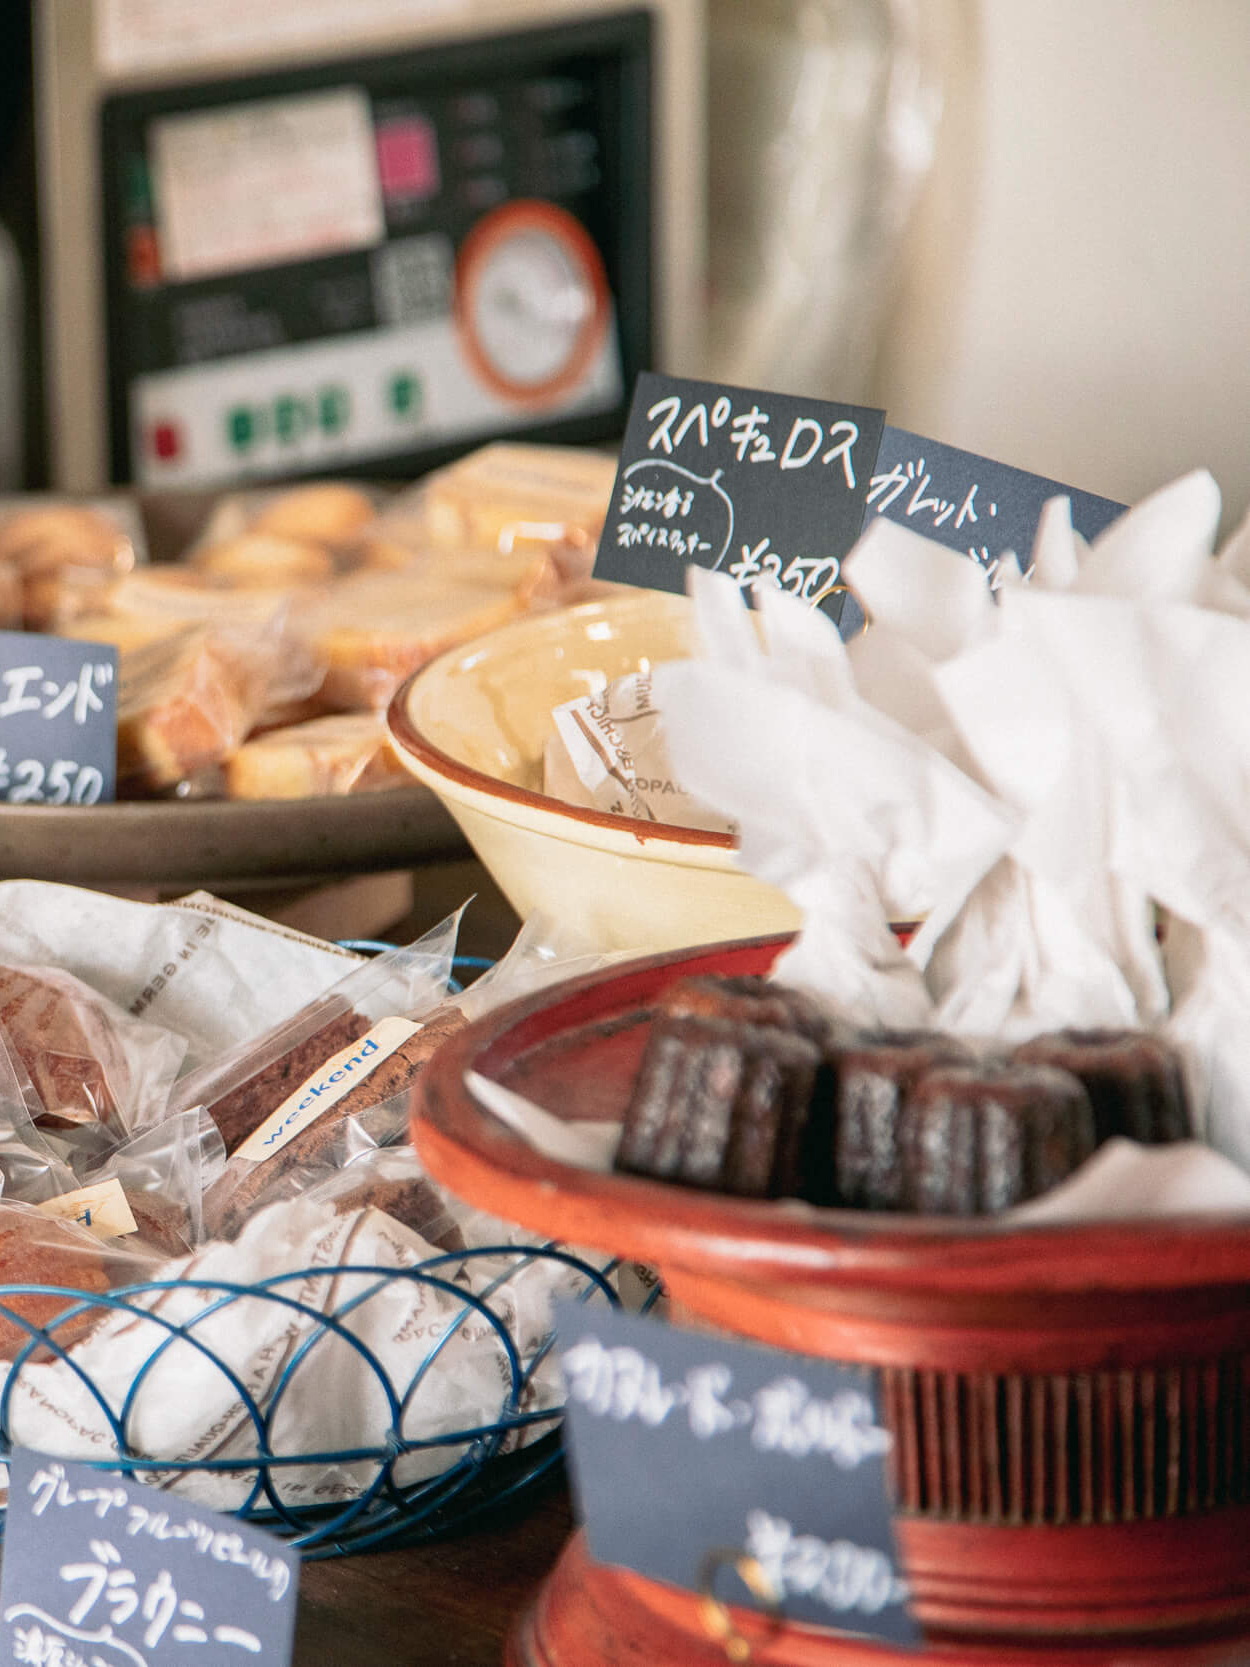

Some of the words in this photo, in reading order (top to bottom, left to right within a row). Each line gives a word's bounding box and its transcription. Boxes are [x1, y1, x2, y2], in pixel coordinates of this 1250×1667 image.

[263, 1038, 380, 1147] weekend
[59, 1539, 261, 1653] ブラウニー
